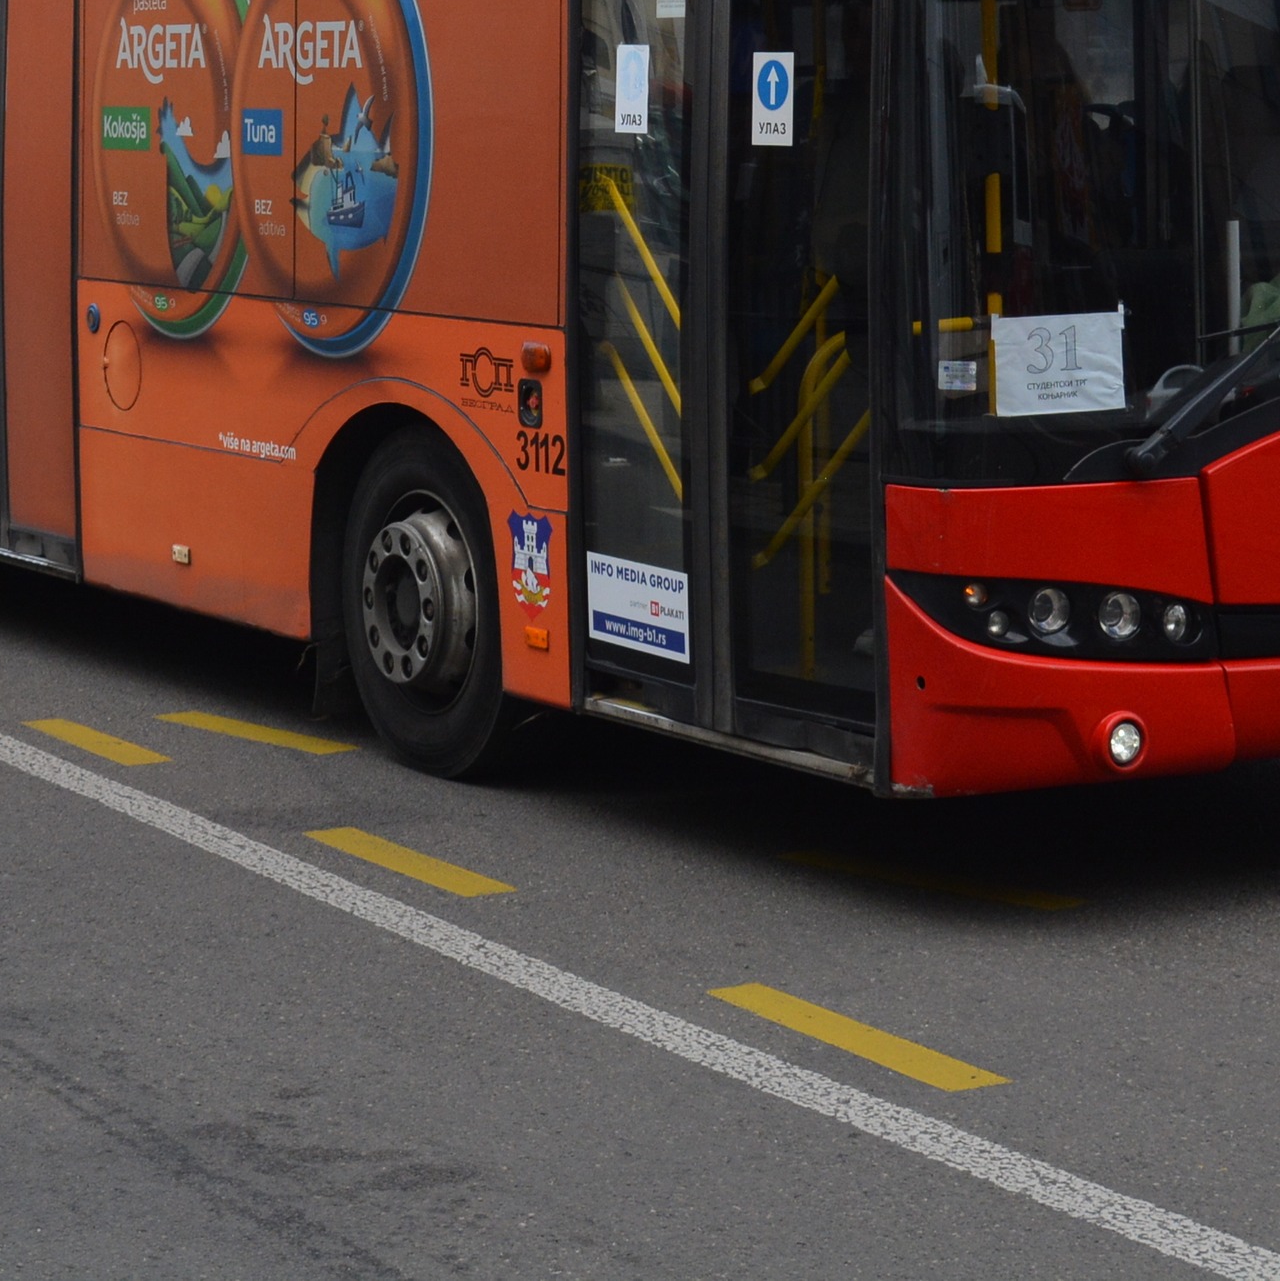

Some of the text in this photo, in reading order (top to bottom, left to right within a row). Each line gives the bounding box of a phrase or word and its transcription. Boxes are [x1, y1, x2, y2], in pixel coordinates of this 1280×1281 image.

[116, 16, 207, 85] ARGETA
[258, 13, 362, 86] ARGETA
[620, 112, 642, 127] УЛАЗ
[103, 113, 147, 145] Kokošja
[244, 118, 276, 145] Tuna
[758, 121, 787, 136] УЛАЗ
[112, 191, 128, 207] BEZ
[254, 199, 273, 215] BEZ
[154, 295, 168, 310] 95
[303, 312, 318, 326] 95
[1026, 324, 1083, 375] 31
[459, 347, 514, 398] ГСП
[1075, 378, 1088, 388] ТРГ
[461, 398, 515, 414] БЕОГРАД
[240, 438, 252, 453] na
[516, 430, 566, 476] 3112
[590, 559, 685, 594] INFO MEDIA GROUP
[660, 605, 685, 620] PLAKATI
[605, 619, 667, 646] www.img-b1.rs
